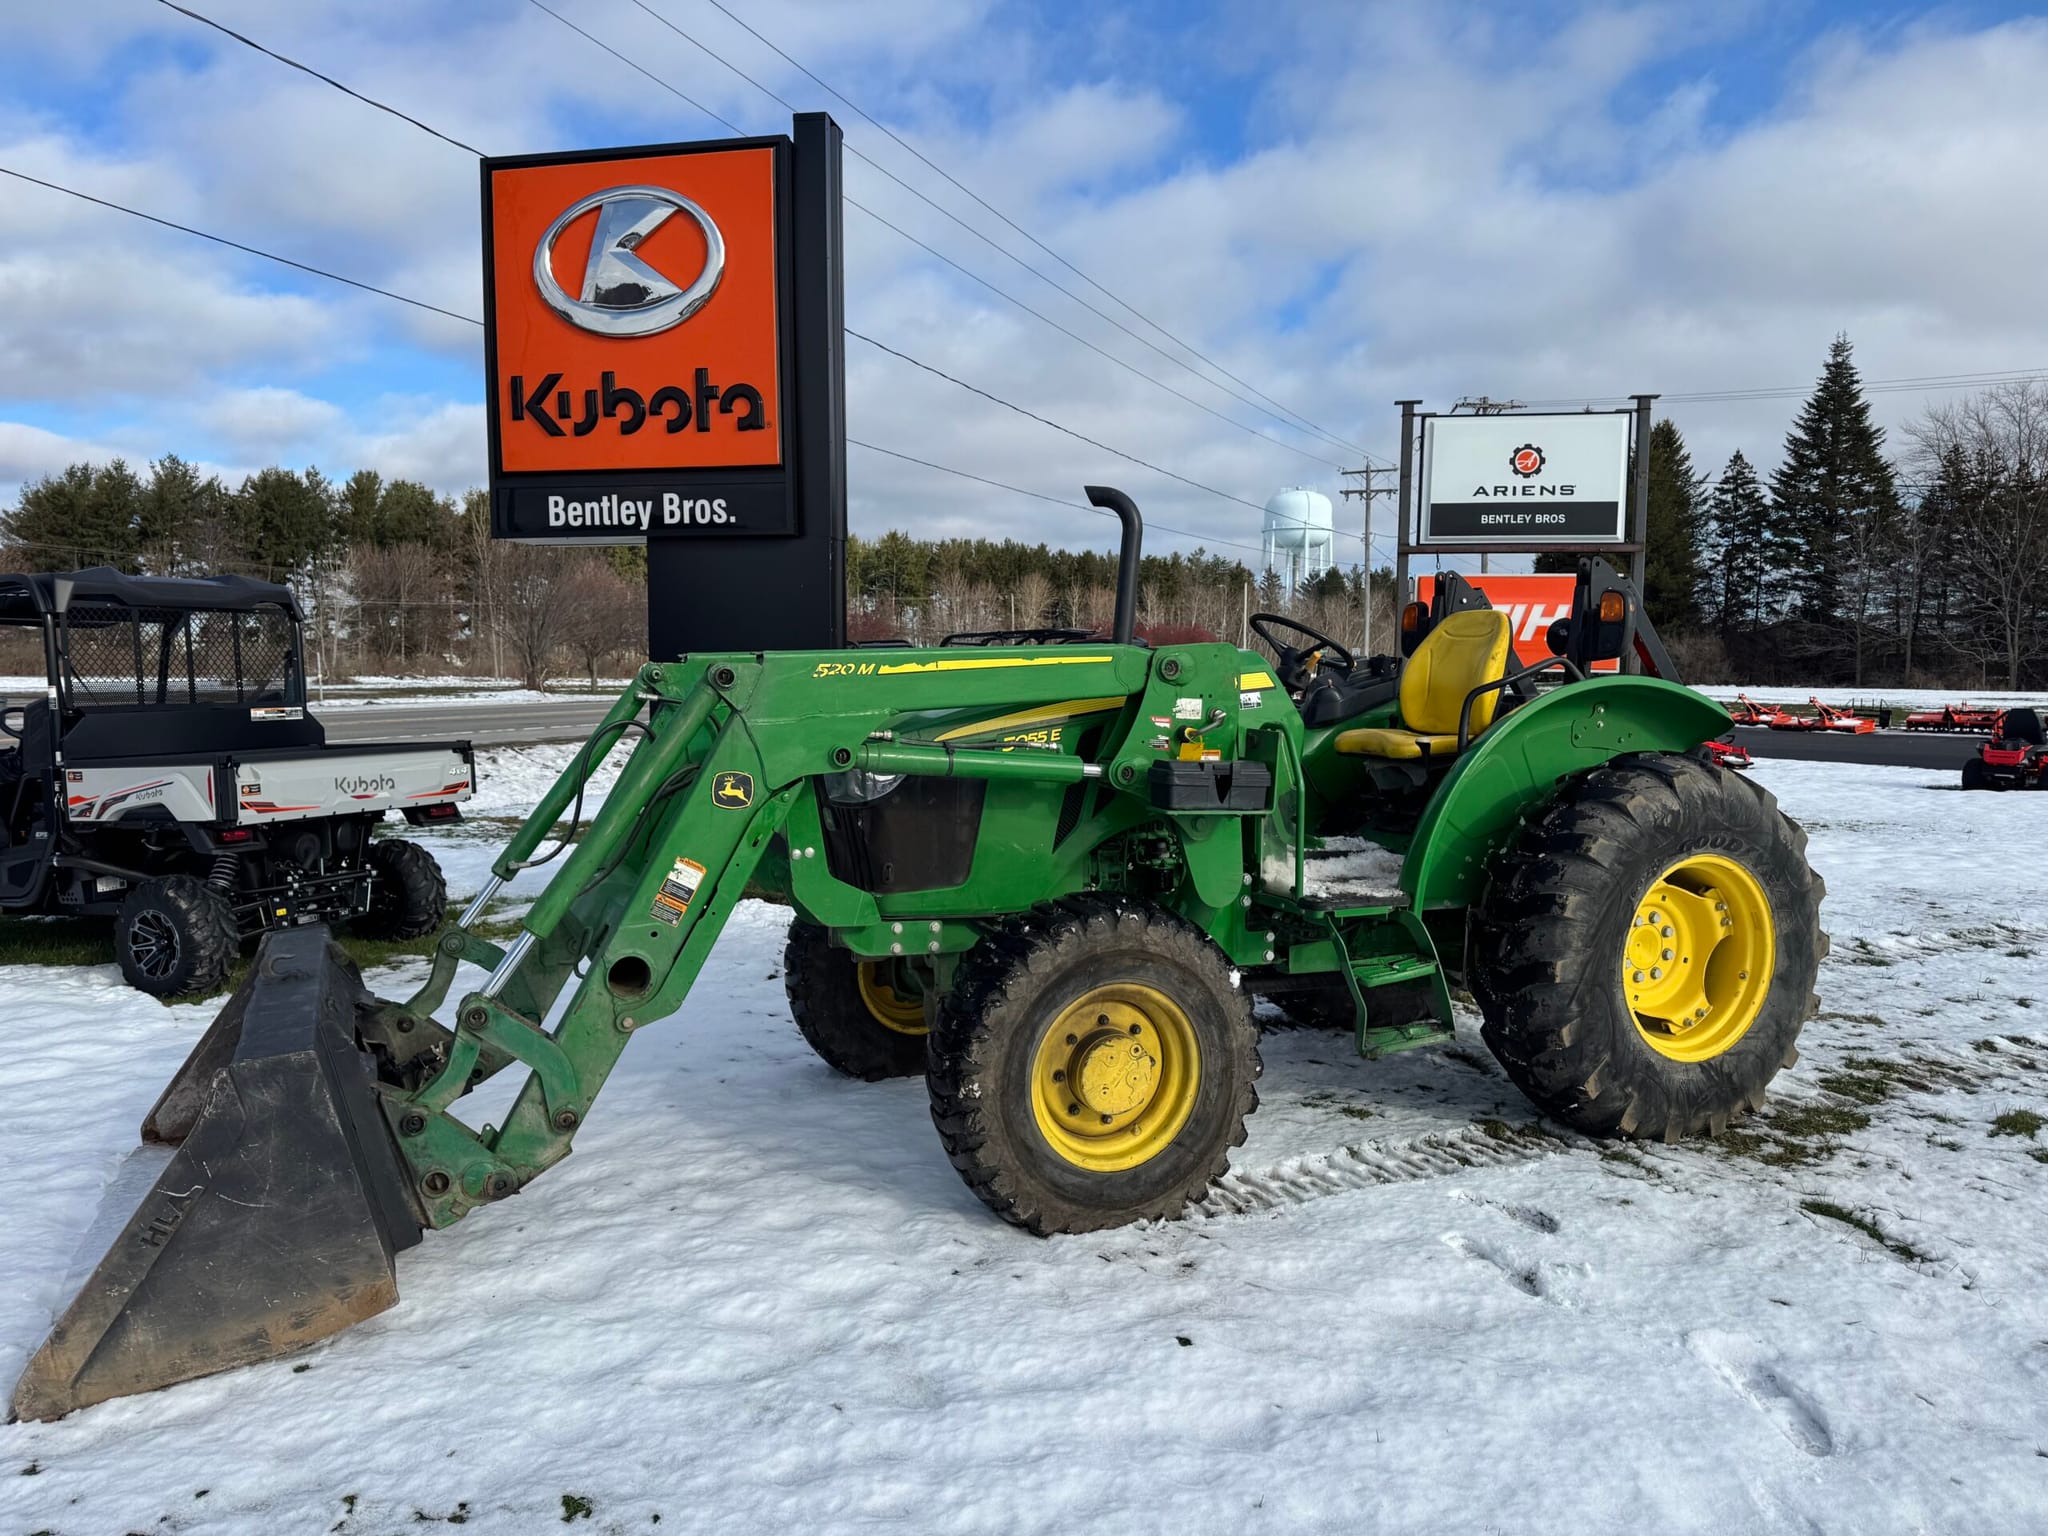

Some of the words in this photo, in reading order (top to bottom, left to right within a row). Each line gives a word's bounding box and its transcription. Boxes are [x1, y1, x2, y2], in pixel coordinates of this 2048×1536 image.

[510, 368, 766, 437] Kubota
[1472, 484, 1576, 497] ARIENS
[548, 494, 653, 531] Bentley
[662, 492, 737, 525] Bros.
[1481, 514, 1532, 524] BENTLEY
[1535, 513, 1566, 524] BROS
[335, 773, 395, 794] Kubota
